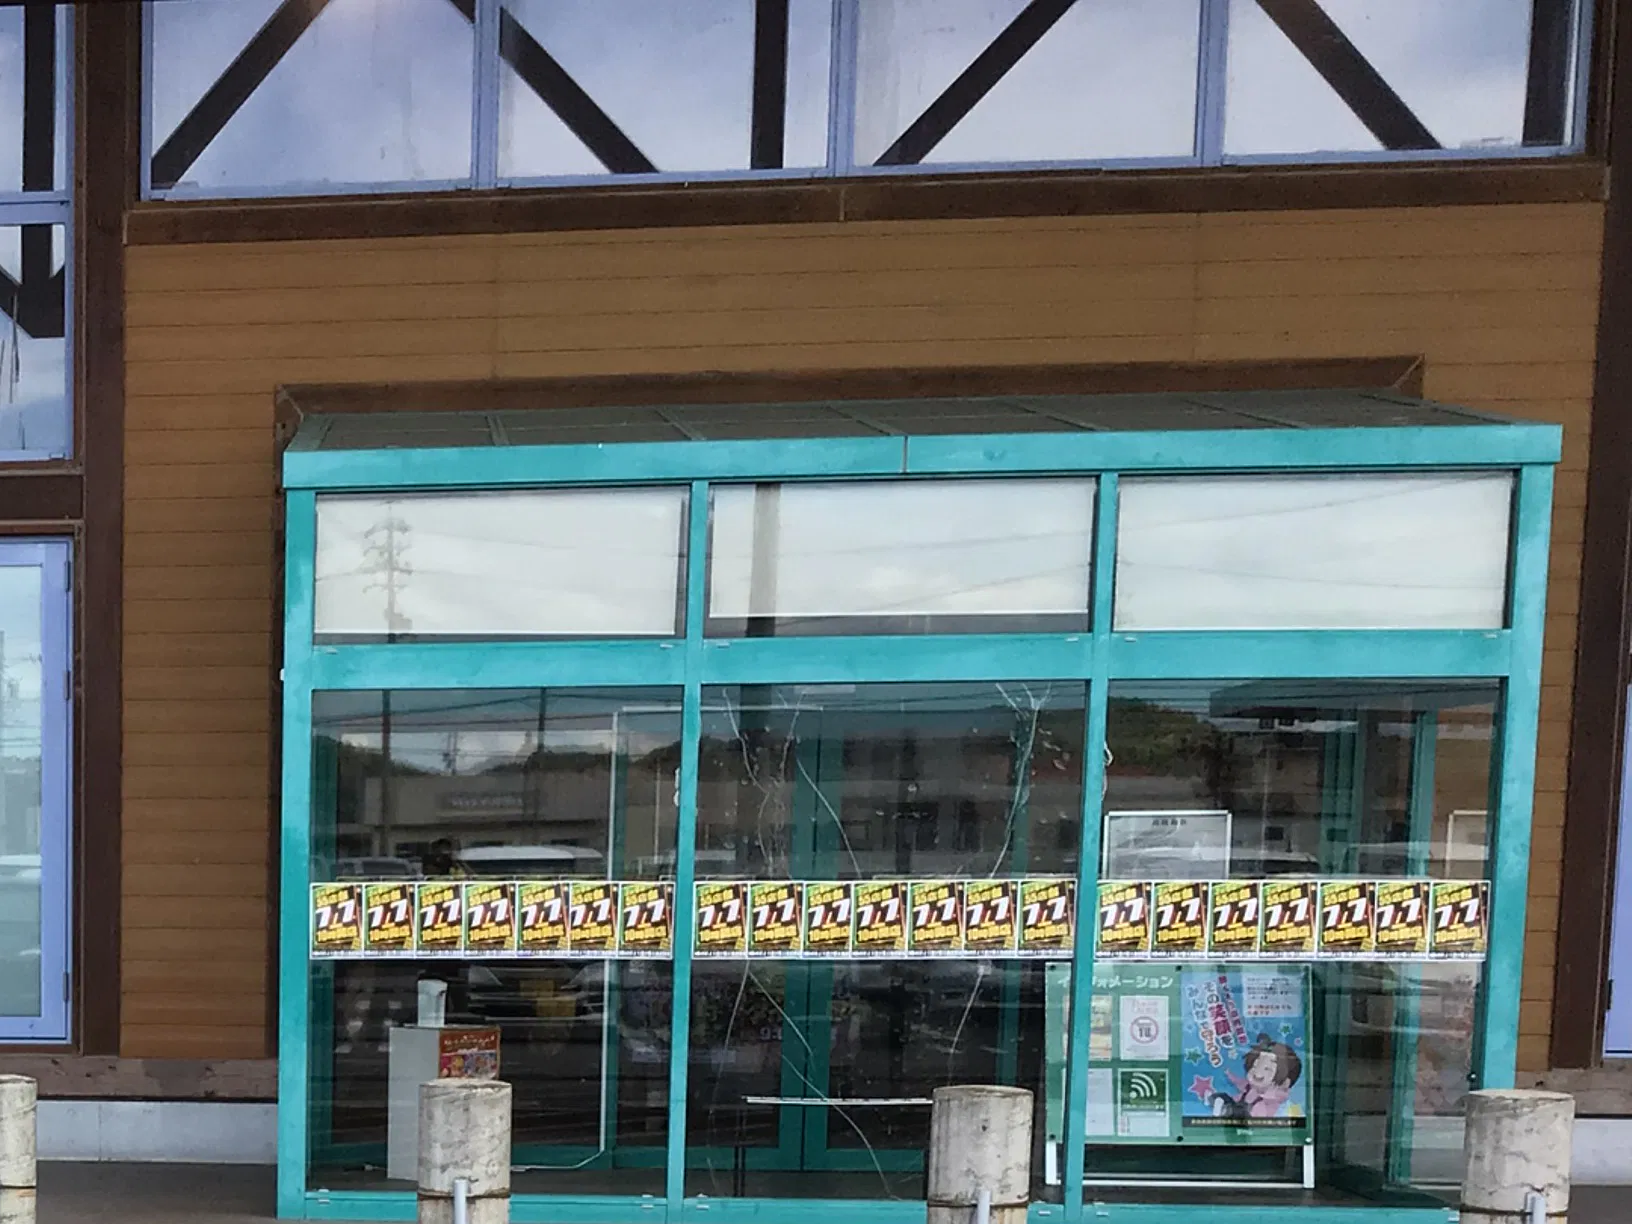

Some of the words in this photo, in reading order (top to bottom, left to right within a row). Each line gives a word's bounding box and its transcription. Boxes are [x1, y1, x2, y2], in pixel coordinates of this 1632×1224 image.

[1057, 975, 1174, 989] イォメーション
